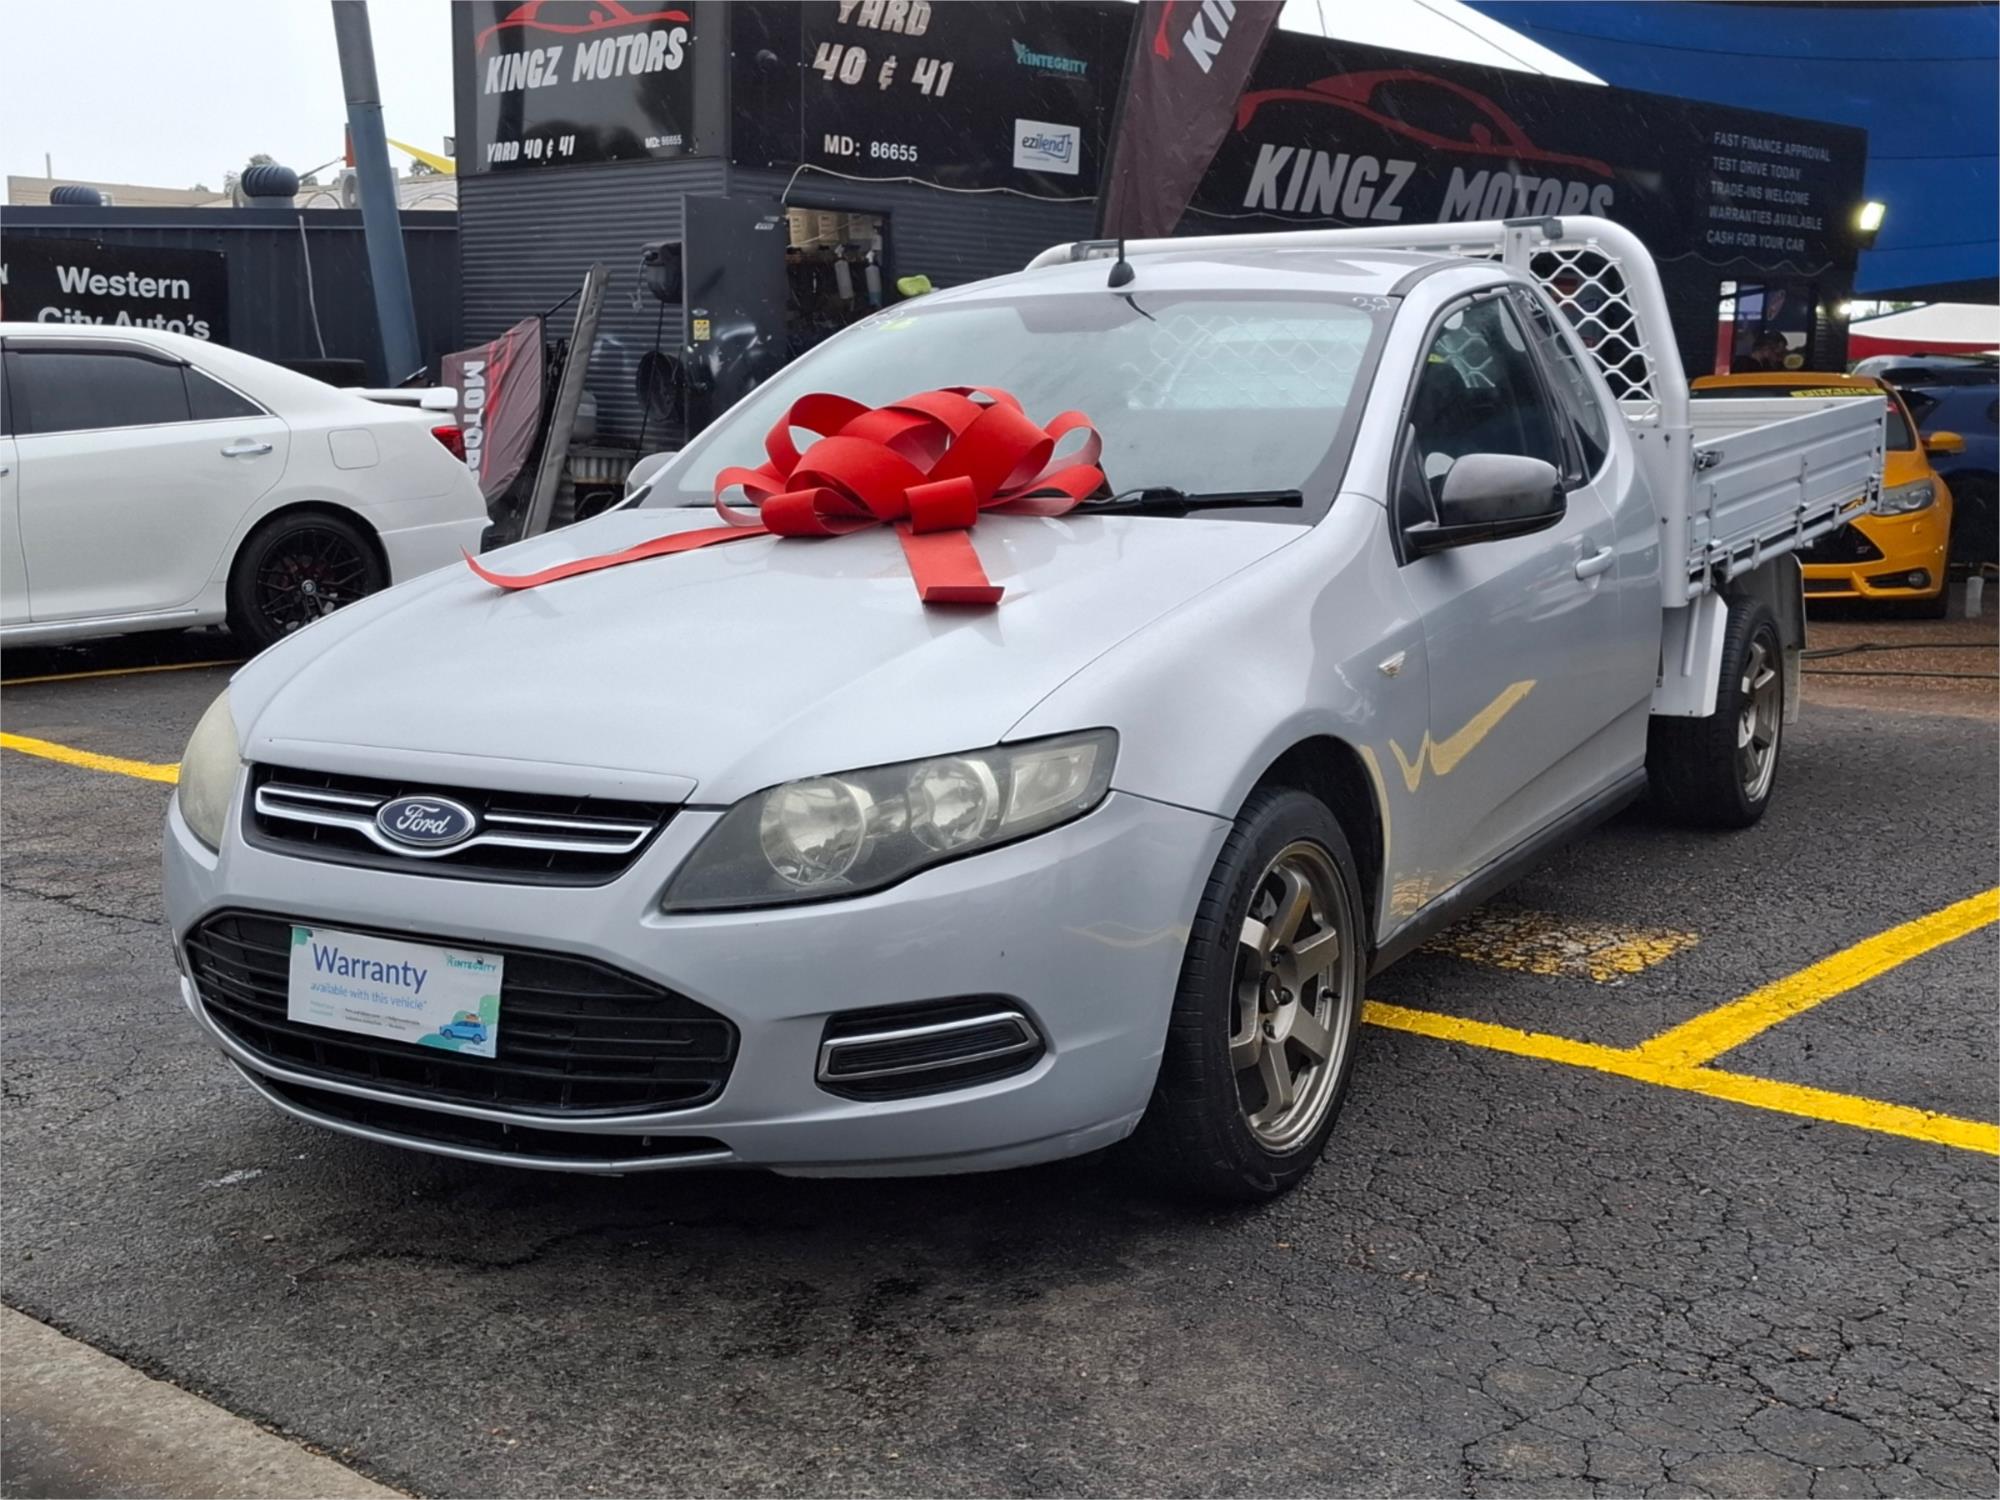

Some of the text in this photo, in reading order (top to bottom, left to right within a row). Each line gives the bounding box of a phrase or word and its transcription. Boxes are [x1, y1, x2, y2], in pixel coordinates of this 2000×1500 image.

[838, 0, 932, 36] YARD
[484, 26, 688, 95] KINGZ MOTORS
[812, 42, 954, 97] 40 & 41
[1027, 52, 1088, 75] INTEGRITY
[487, 143, 519, 163] YARD
[524, 138, 543, 159] 40
[559, 134, 576, 156] 41
[824, 134, 918, 162] MD: 86655
[1022, 133, 1064, 153] ezilend
[1713, 131, 1832, 162] FAST FINANCE APPROVAL
[1243, 143, 1417, 222] KINGZ
[1712, 156, 1802, 182] TEST DRIVE TODAY
[1710, 180, 1810, 206] TRADE-INS WELCOME
[1709, 205, 1823, 231] WARRANTIES AVAILABLE
[1706, 230, 1806, 253] CASH FOR YOUR CAR
[56, 265, 190, 299] Western
[114, 310, 211, 340] Auto's
[396, 803, 452, 835] Ford
[312, 943, 428, 995] Warranty
[310, 982, 348, 998] available
[349, 988, 370, 1002] with
[371, 991, 389, 1005] this
